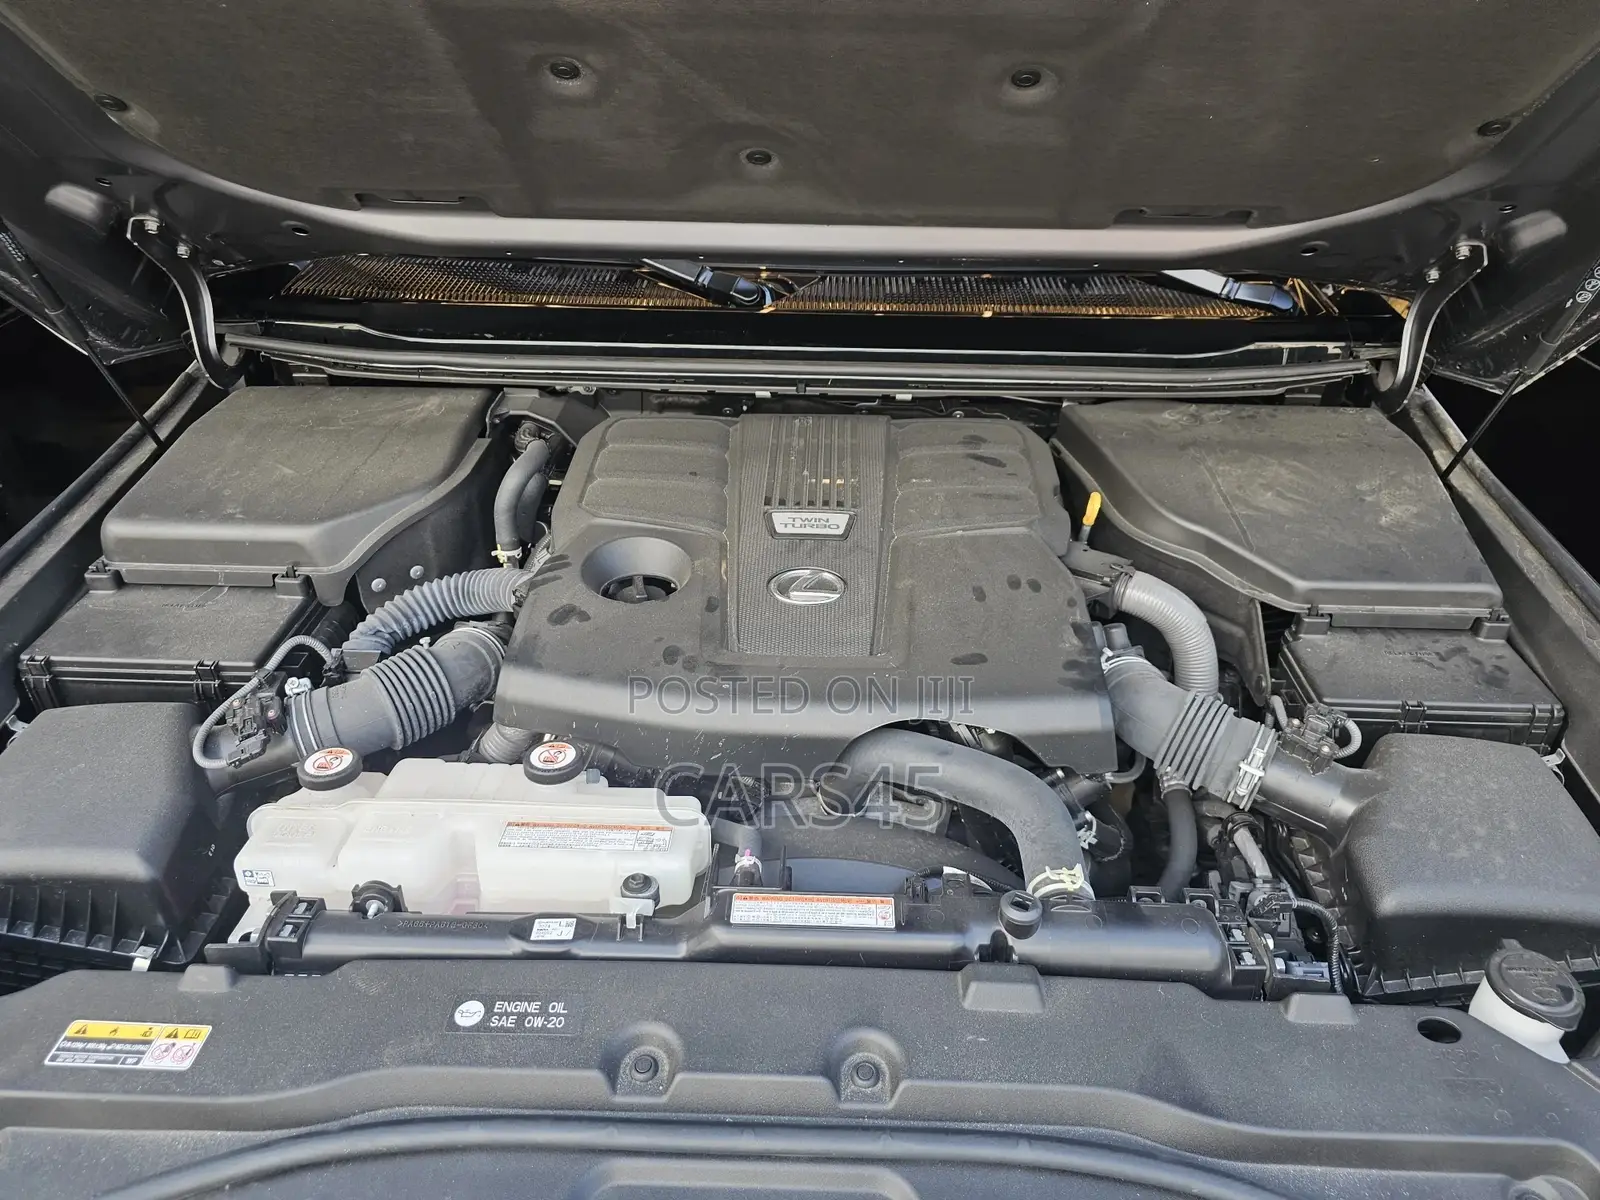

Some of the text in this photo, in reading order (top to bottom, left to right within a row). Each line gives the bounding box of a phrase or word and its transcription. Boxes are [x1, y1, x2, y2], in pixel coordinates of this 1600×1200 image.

[493, 1001, 568, 1014] ENGINE OIL
[489, 1016, 565, 1028] SAE 0W-20
